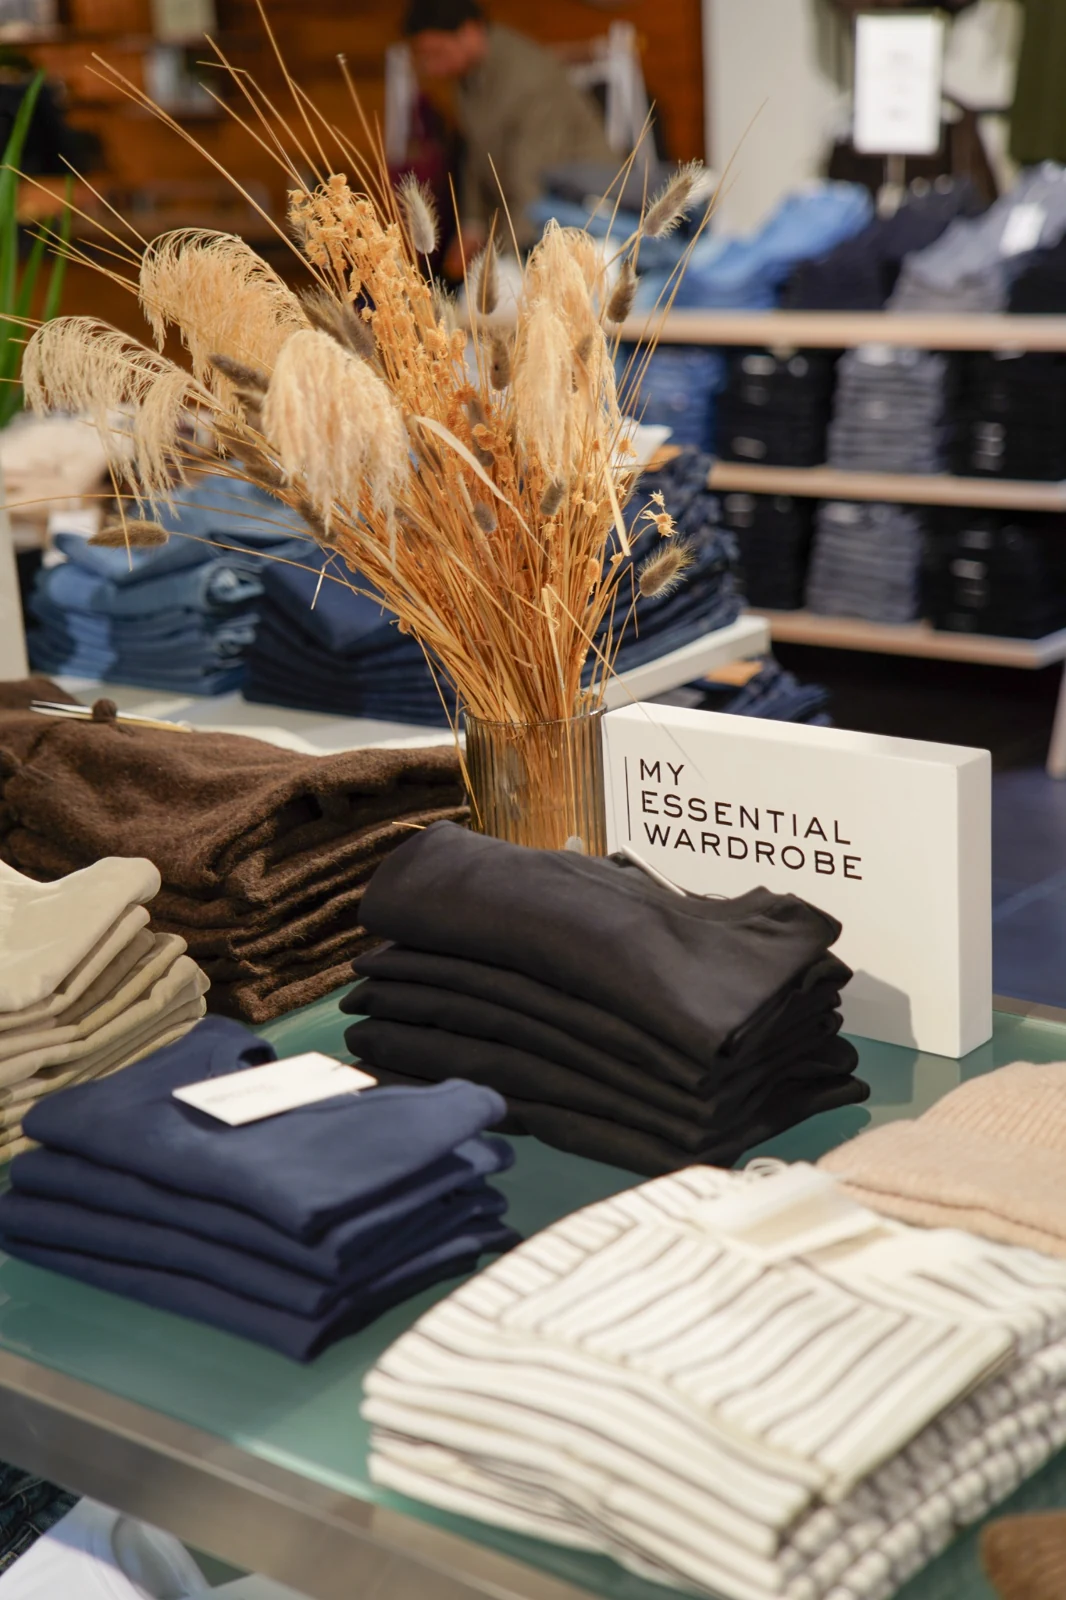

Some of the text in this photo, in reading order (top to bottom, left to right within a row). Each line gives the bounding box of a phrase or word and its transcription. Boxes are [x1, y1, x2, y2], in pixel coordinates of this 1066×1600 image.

[639, 758, 685, 786] MY
[641, 790, 851, 846] ESSENTIAL
[643, 822, 863, 881] WARDROBE
